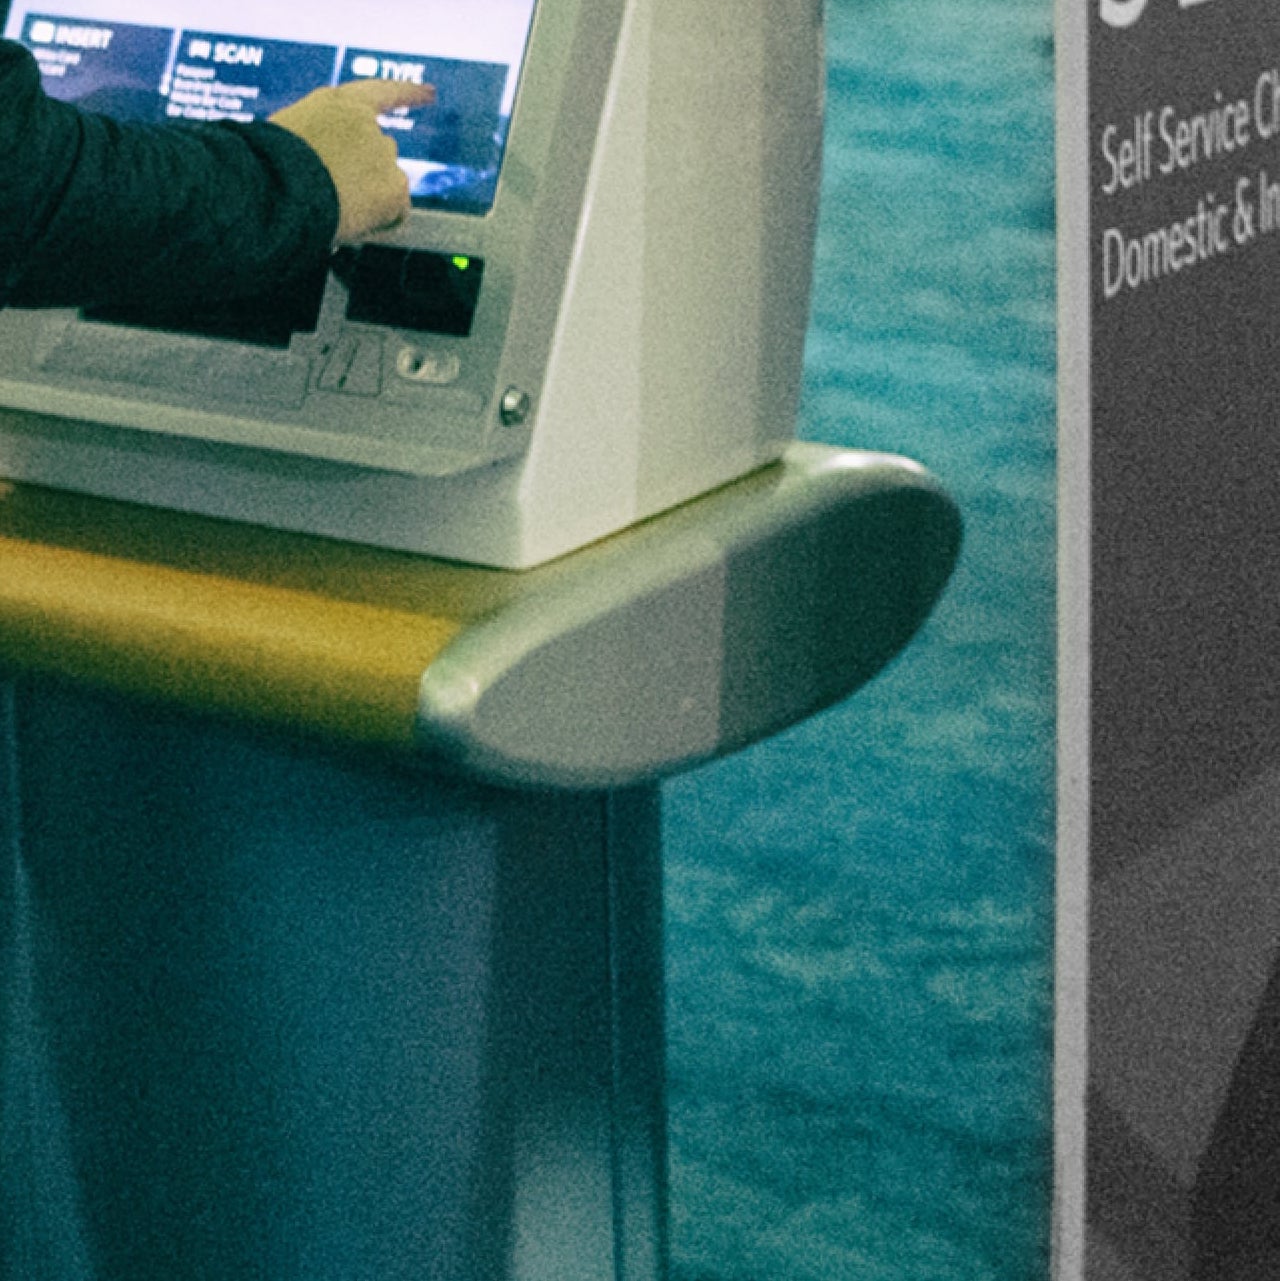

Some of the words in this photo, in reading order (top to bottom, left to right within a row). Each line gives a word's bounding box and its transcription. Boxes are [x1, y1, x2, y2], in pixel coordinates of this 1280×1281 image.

[55, 23, 114, 50] INSERT
[213, 41, 263, 68] SCAN
[380, 59, 426, 86] TYPE
[1101, 109, 1154, 195] Self
[1158, 89, 1250, 174] Service
[1102, 192, 1229, 299] Domestic
[1234, 176, 1255, 245] &
